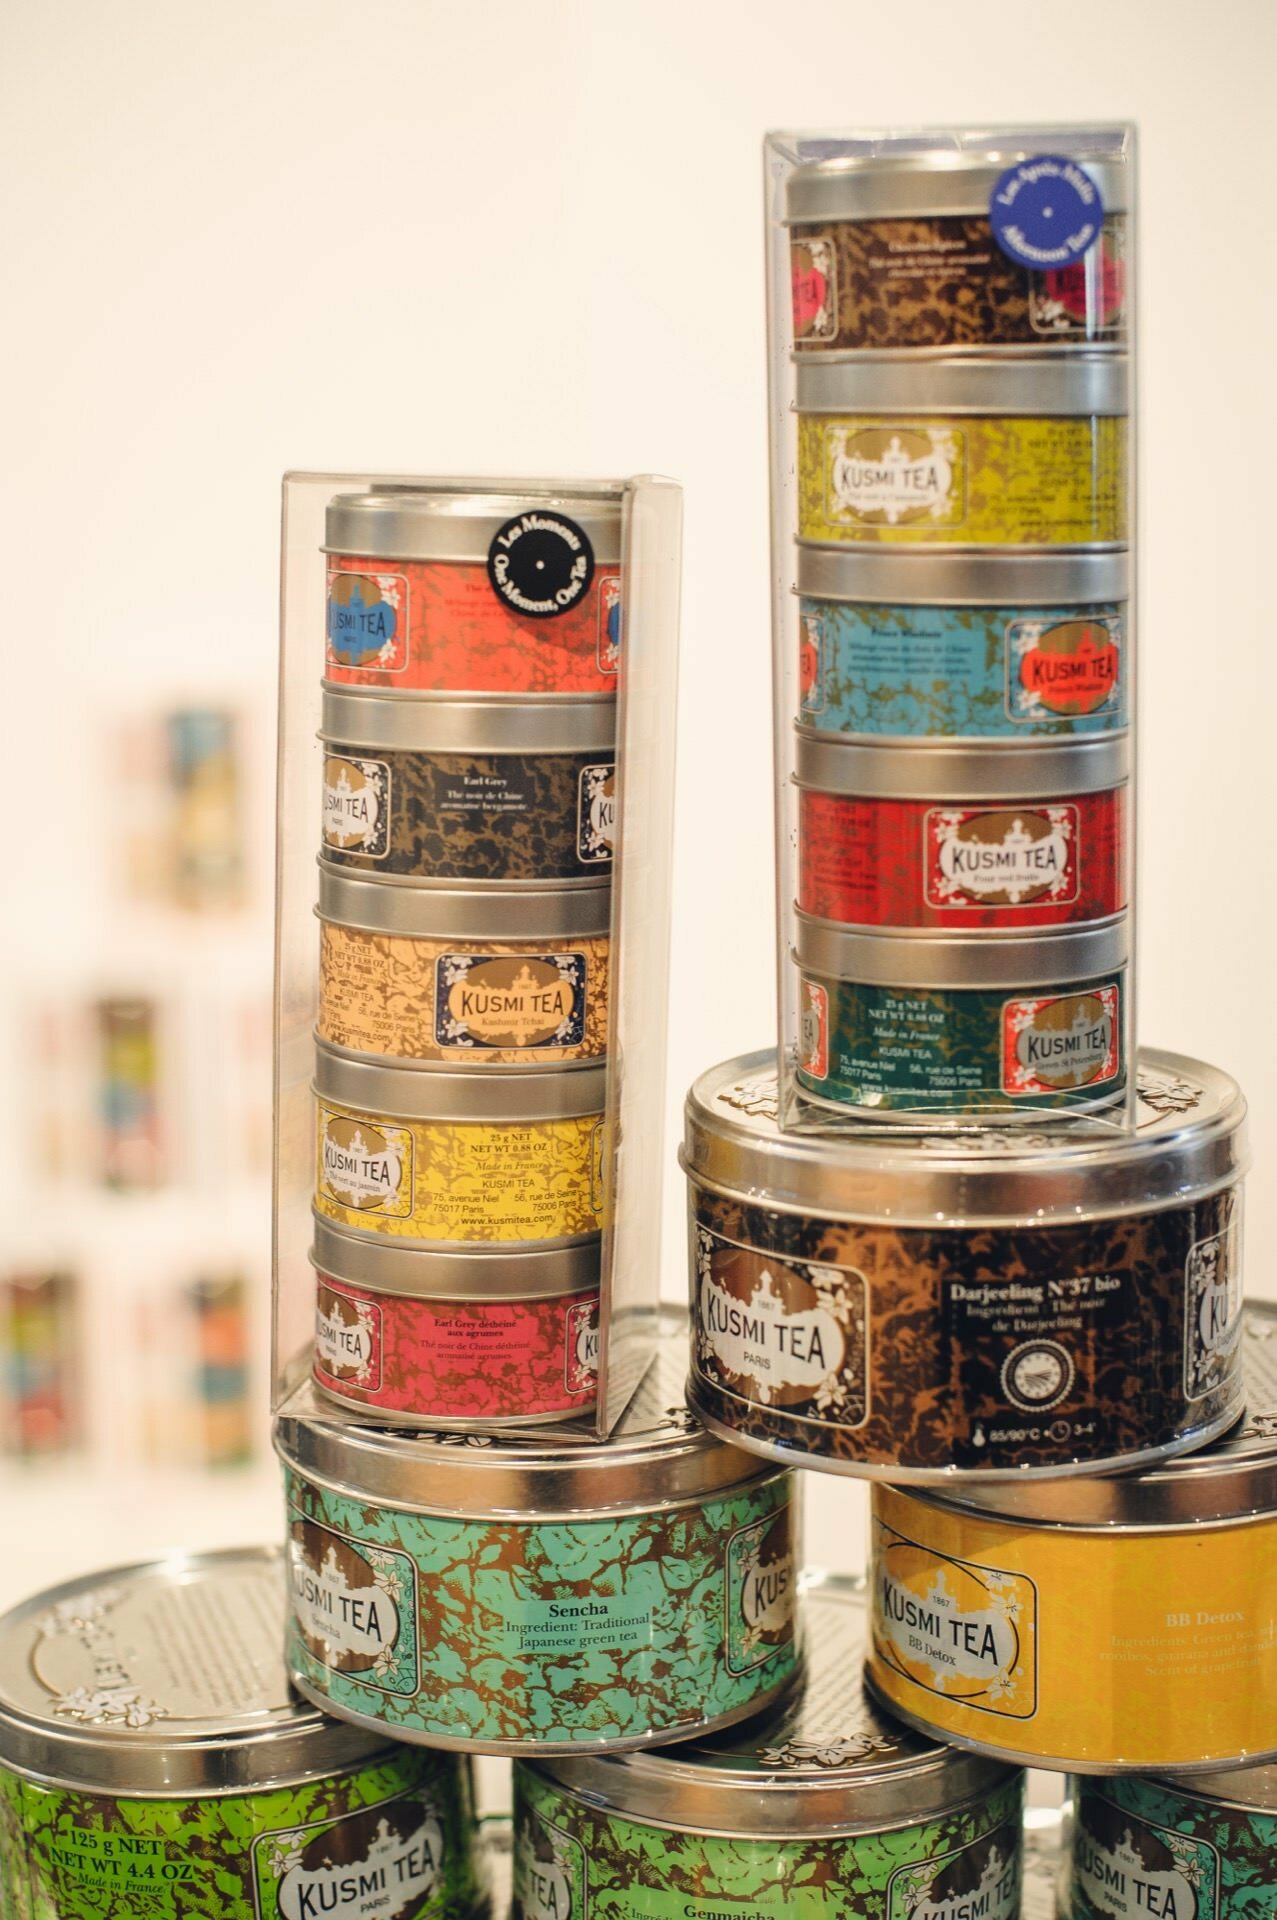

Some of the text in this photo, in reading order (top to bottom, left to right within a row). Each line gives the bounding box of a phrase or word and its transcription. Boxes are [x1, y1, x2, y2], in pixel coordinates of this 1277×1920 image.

[841, 464, 939, 492] KUSMI TEA
[498, 514, 582, 551] Les Moments
[494, 553, 588, 612] One Moment, One Tea
[359, 611, 387, 639] TEA
[1032, 659, 1087, 687] KUSMI
[463, 776, 508, 788] Earl Grey
[345, 797, 369, 823] TEA
[952, 845, 1058, 874] KUSMI TEA
[360, 991, 374, 1002] TEA
[461, 989, 564, 1017] KUSMI TEA
[905, 1000, 928, 1011] NET
[482, 1017, 518, 1026] Kashmir
[868, 1008, 888, 1020] NET
[395, 1023, 416, 1033] Paris
[1028, 1024, 1107, 1063] KUSMI TEA
[879, 1046, 933, 1060] KUSMI TEA
[861, 1068, 882, 1081] Paris
[941, 1065, 954, 1075] de
[956, 1064, 983, 1075] Seine
[958, 1076, 982, 1087] Paris
[490, 1134, 502, 1142] 25
[511, 1132, 533, 1142] NET
[470, 1142, 548, 1153] NET WT 0.88 OZ
[324, 1142, 391, 1187] KUSMI TEA
[475, 1161, 545, 1171] Made in France
[357, 1181, 381, 1192] jasmin
[482, 1178, 536, 1189] KUSMI TEA
[448, 1194, 481, 1203] avenue
[482, 1194, 500, 1203] Niel
[514, 1189, 577, 1204] 56, rue de Seine
[532, 1199, 577, 1211] 75006 Paris
[433, 1203, 485, 1214] 75017 Paris
[461, 1213, 553, 1225] www.kusmitea.com
[951, 1282, 1043, 1306] Darjeeling
[1094, 1274, 1121, 1293] bio
[434, 1318, 453, 1327] Earl
[454, 1319, 476, 1329] Grey
[707, 1288, 826, 1370] KUSMI TEA
[447, 1329, 504, 1339] aux agrumes
[339, 1331, 362, 1359] TEA
[437, 1341, 456, 1349] noir
[456, 1341, 468, 1350] de
[469, 1341, 494, 1350] Chine
[477, 1353, 513, 1362] agrumes
[743, 1351, 772, 1370] PARIS
[549, 1602, 608, 1618] Sencha
[1166, 1610, 1246, 1628] BB Detox
[338, 1596, 383, 1643] TEA
[505, 1613, 650, 1636] Ingredient: Traditional
[884, 1577, 999, 1667] KUSMI TEA
[517, 1631, 638, 1650] Japanese green tea
[908, 1634, 957, 1666] BB Detox
[70, 1830, 163, 1857] 125 g NET
[51, 1846, 194, 1880] NET WT 4.4 OZ
[77, 1872, 164, 1894] Made in France
[297, 1838, 435, 1920] KUSMI TEA
[529, 1868, 559, 1920] TEA
[1132, 1878, 1178, 1920] TEA
[360, 1894, 391, 1913] PARIS
